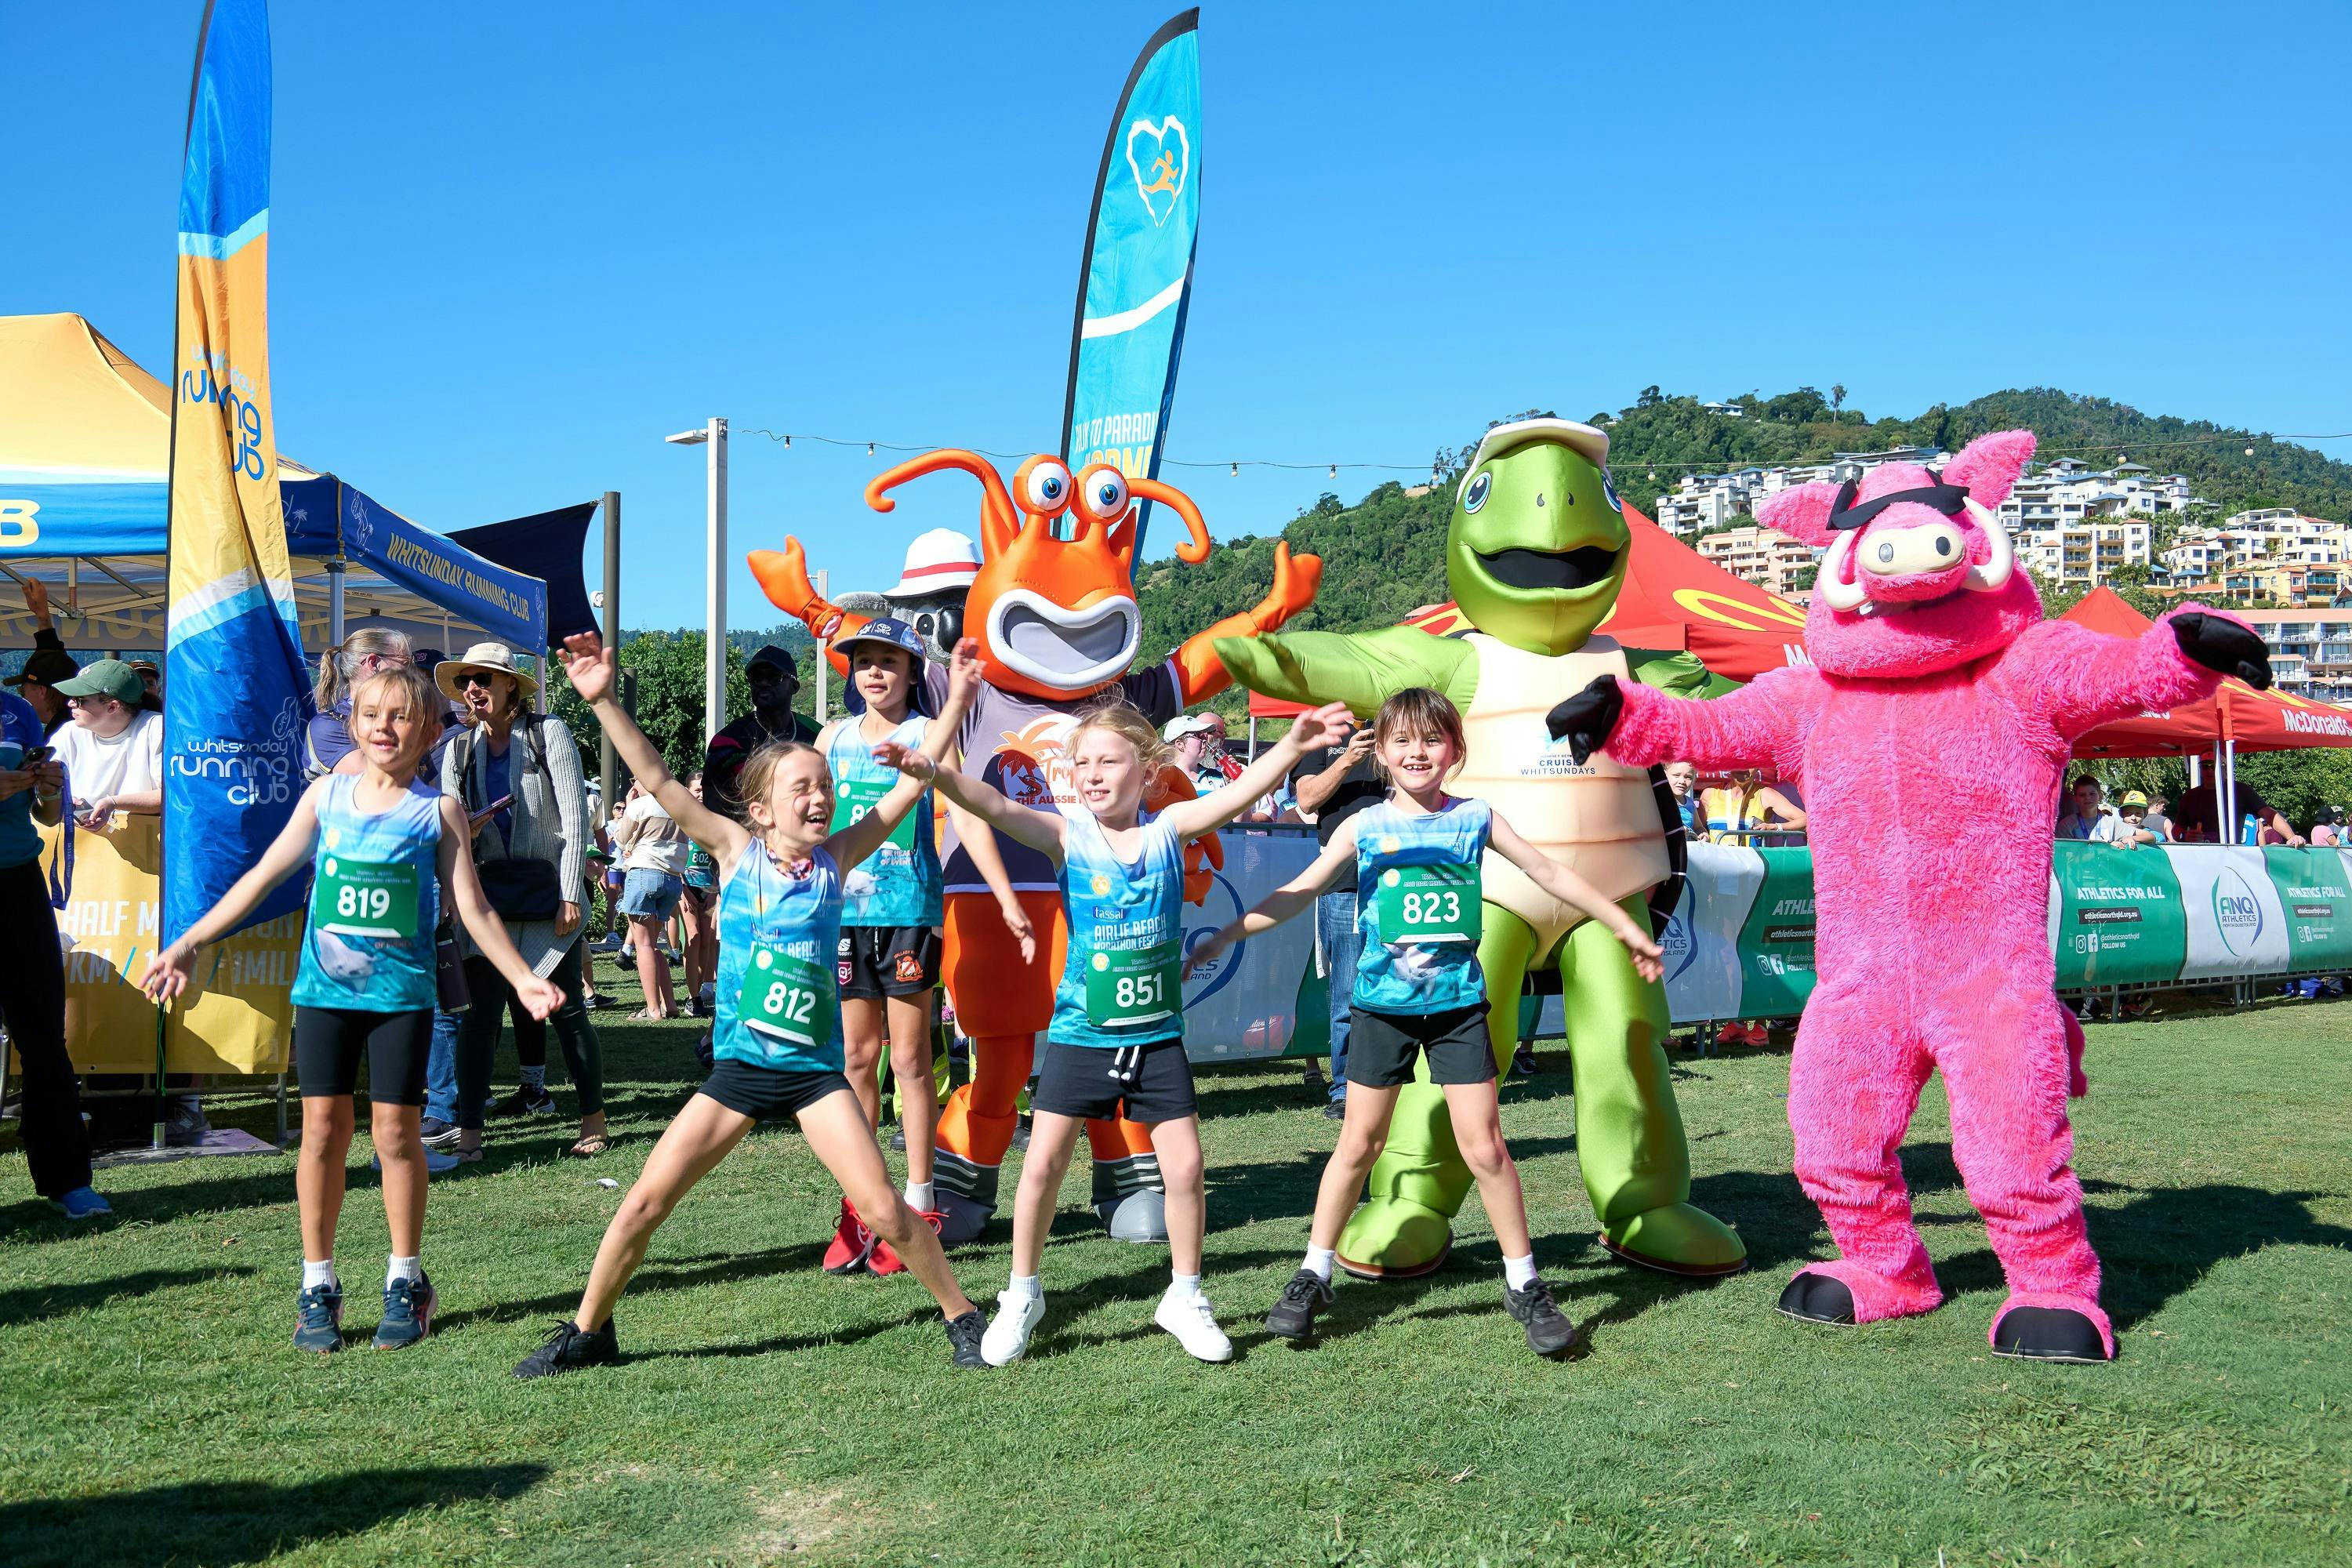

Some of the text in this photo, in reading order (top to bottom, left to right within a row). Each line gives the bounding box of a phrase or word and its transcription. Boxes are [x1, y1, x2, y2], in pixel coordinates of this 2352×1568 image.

[1091, 418, 1102, 446] TO
[1104, 412, 1159, 444] PARADI
[387, 532, 531, 622] WHITSUNDAY RUNNING CLUB
[187, 739, 289, 756] whitsunday
[170, 755, 290, 782] running
[227, 775, 290, 805] club
[1015, 797, 1036, 805] THE
[1037, 795, 1076, 804] AUSSIE
[691, 852, 710, 863] 802
[337, 884, 390, 920] 819
[2077, 886, 2165, 900] ATHLETICS FOR ALL
[2286, 886, 2346, 898] ATHLETICS FOR ALL
[1095, 906, 1123, 920] tassal
[1403, 891, 1461, 924] 823
[2084, 910, 2138, 920] athleticsnorthqld.org.au
[2220, 896, 2255, 915] ANQ
[63, 900, 130, 937] HALF
[1094, 912, 1167, 942] AIRLIE BEACH
[2222, 914, 2256, 923] ATHLETICS
[1094, 938, 1136, 951] MARATHON
[1138, 929, 1168, 948] FESTIVAL
[1770, 927, 1816, 938] athleticsnorth
[1787, 964, 1809, 972] FOLLOW
[1116, 972, 1163, 1008] 851
[763, 981, 816, 1025] 812
